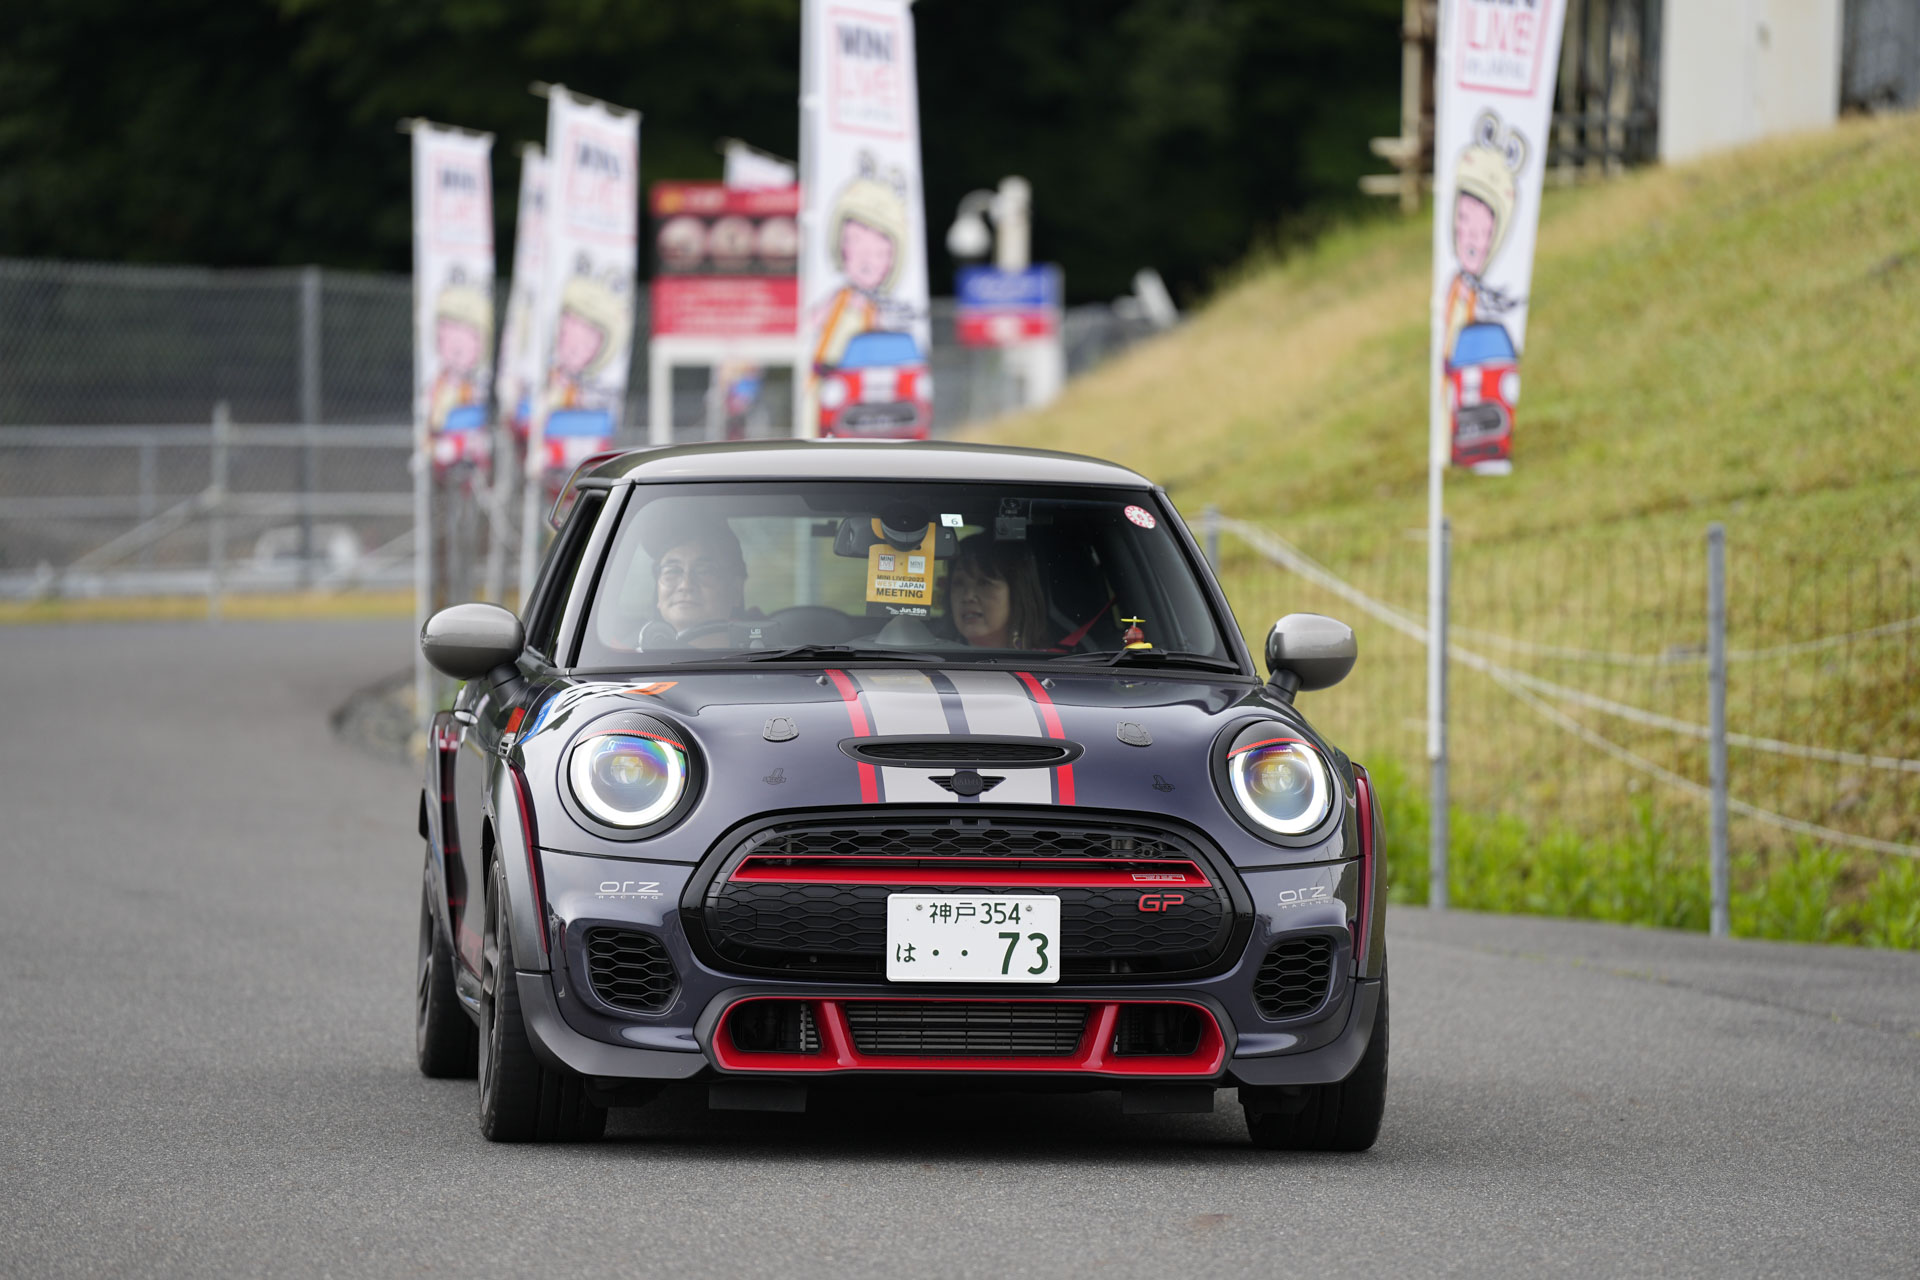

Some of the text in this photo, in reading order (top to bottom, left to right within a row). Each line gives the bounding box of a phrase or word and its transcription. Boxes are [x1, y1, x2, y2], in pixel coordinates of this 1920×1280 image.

[876, 588, 924, 599] MEETING
[599, 881, 660, 893] orz
[1279, 886, 1327, 902] orz
[1138, 894, 1185, 912] GP
[896, 942, 917, 963] は
